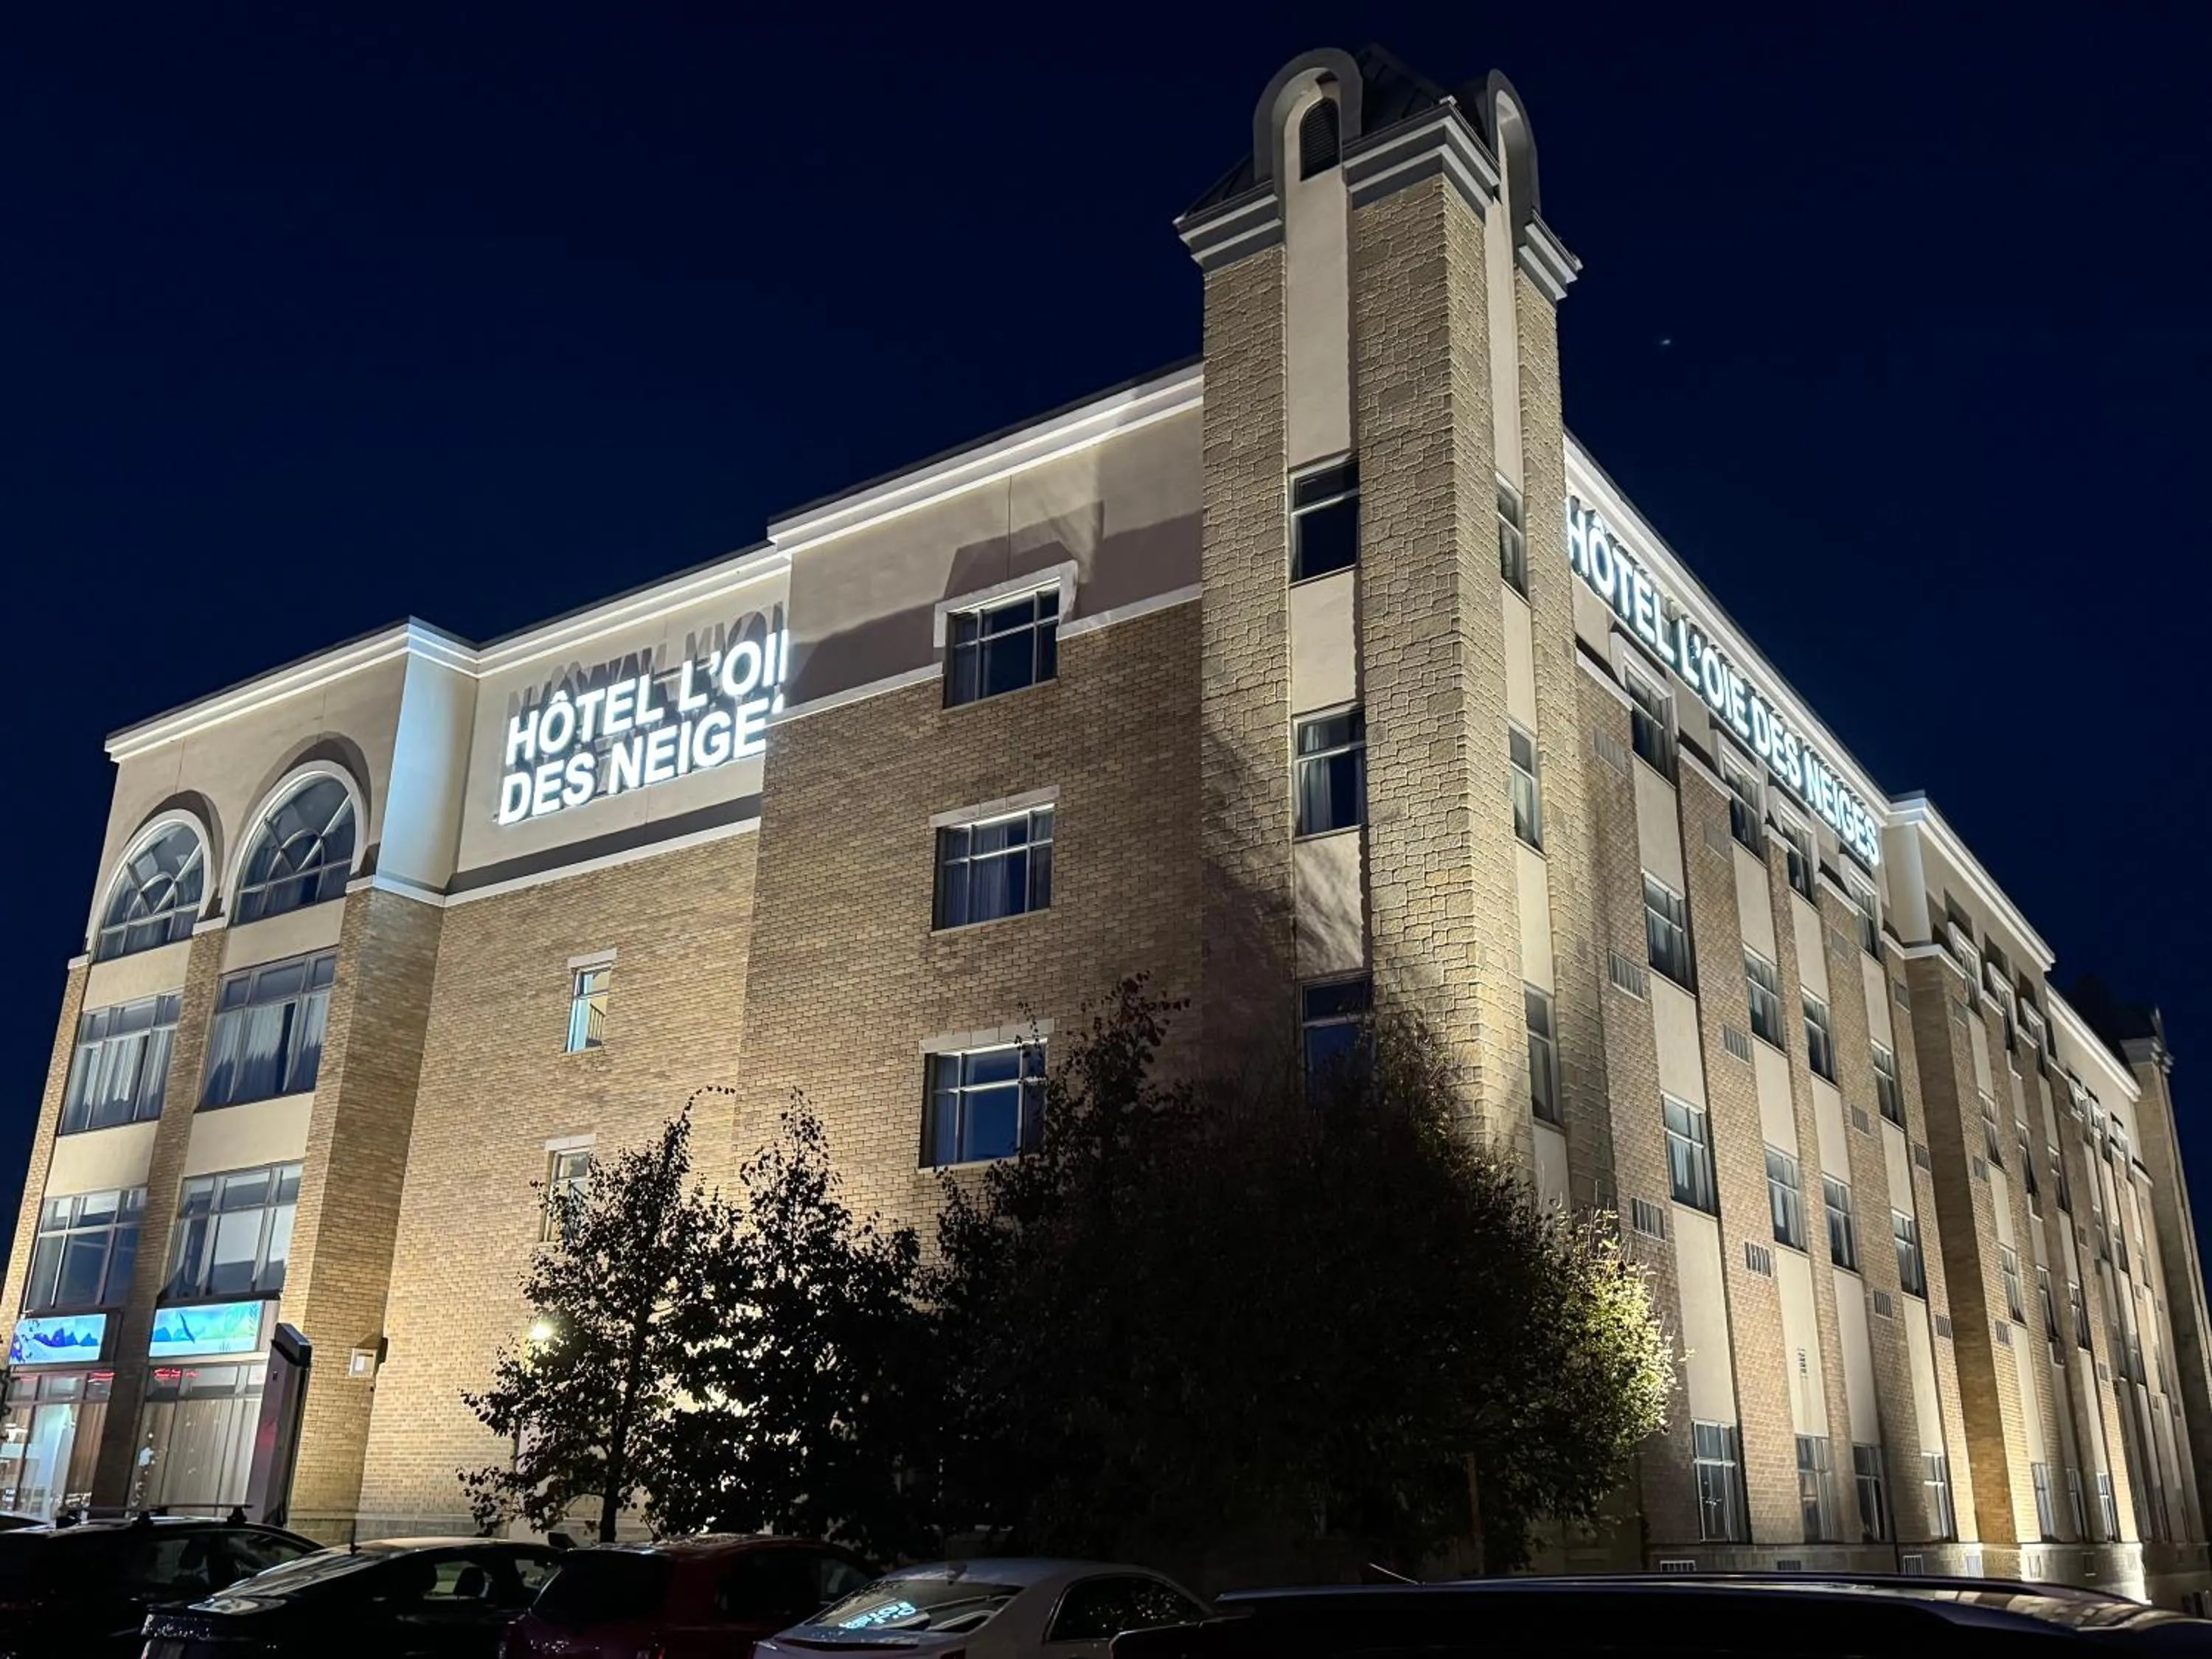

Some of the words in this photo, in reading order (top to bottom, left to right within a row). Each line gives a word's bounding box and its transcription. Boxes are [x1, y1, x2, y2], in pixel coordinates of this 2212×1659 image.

[504, 672, 664, 768] HÔTEL
[1565, 495, 1674, 662] HÔTEL
[1751, 695, 1802, 789] DES
[1804, 750, 1880, 867] NEIGES
[498, 752, 599, 826] DES
[608, 692, 785, 796] NEIGE
